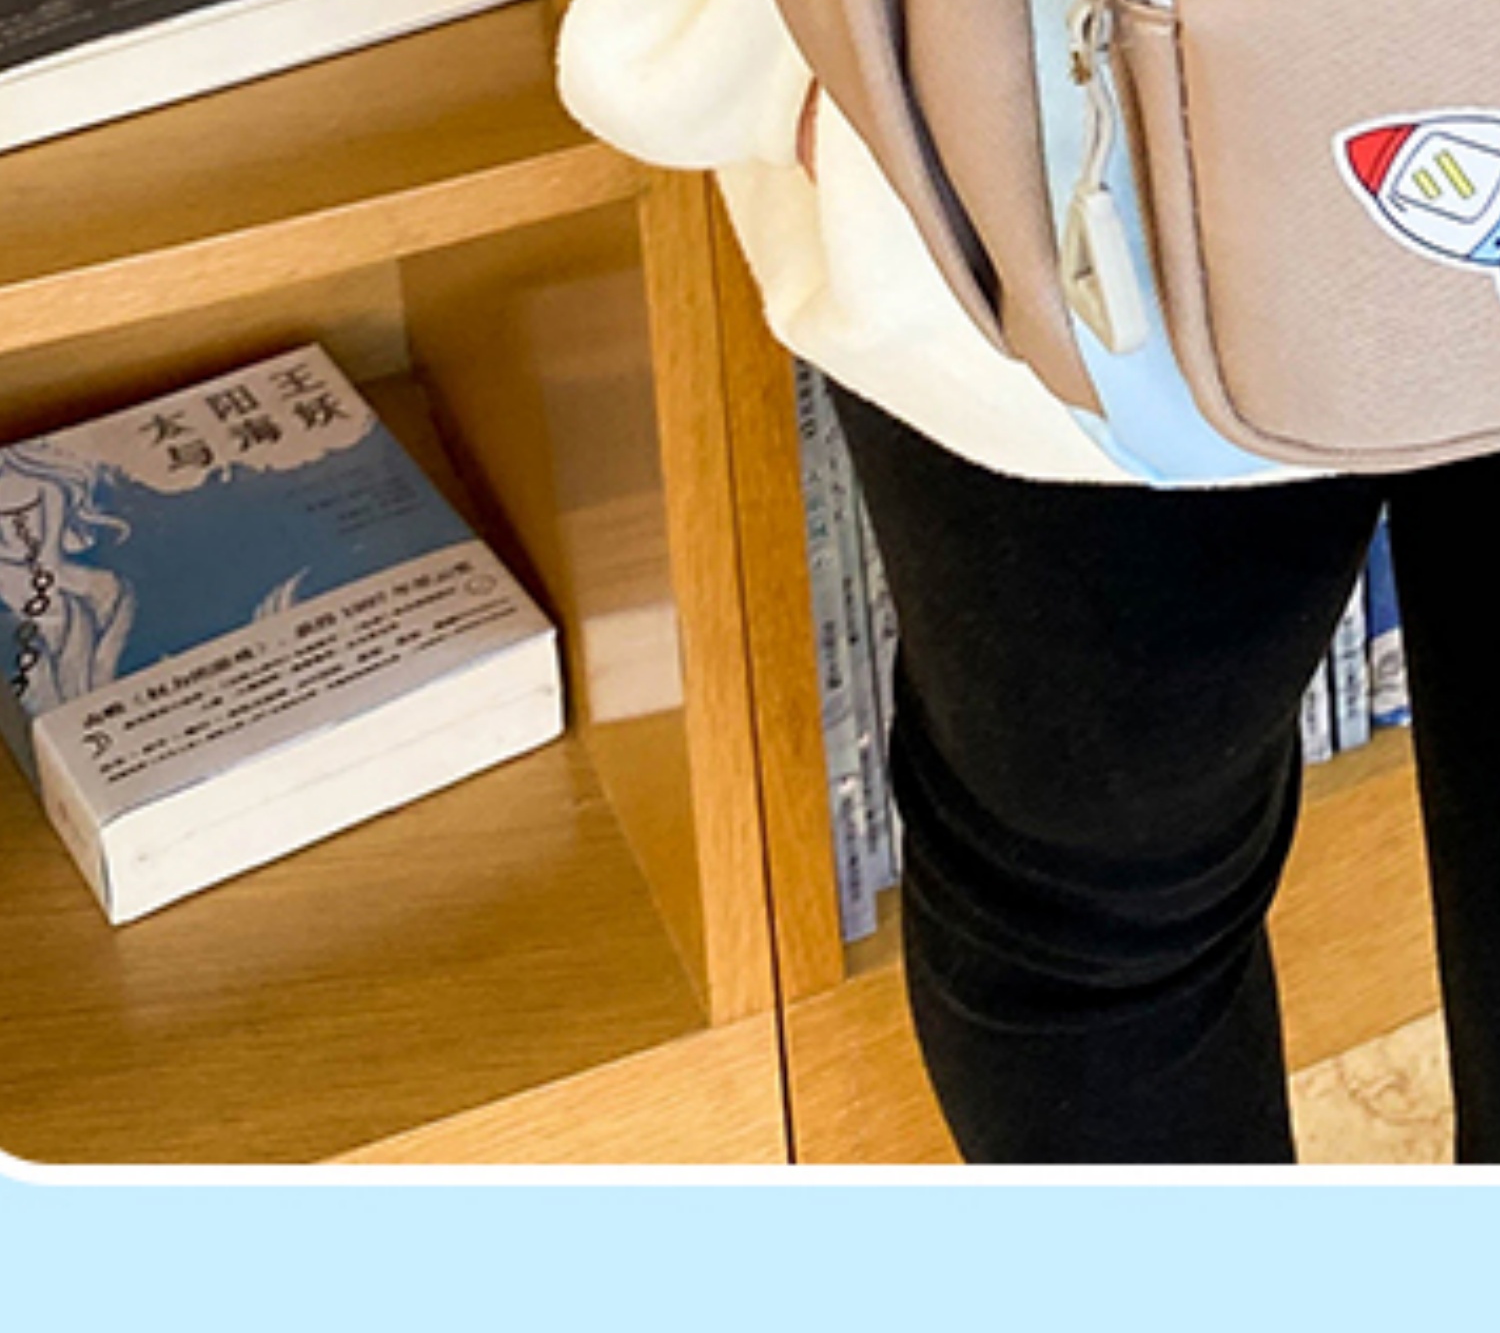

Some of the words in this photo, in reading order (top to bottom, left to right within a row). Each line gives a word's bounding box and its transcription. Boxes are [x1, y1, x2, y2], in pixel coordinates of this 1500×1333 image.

[137, 361, 325, 445] 太阳王
[167, 392, 351, 473] 与海妖
